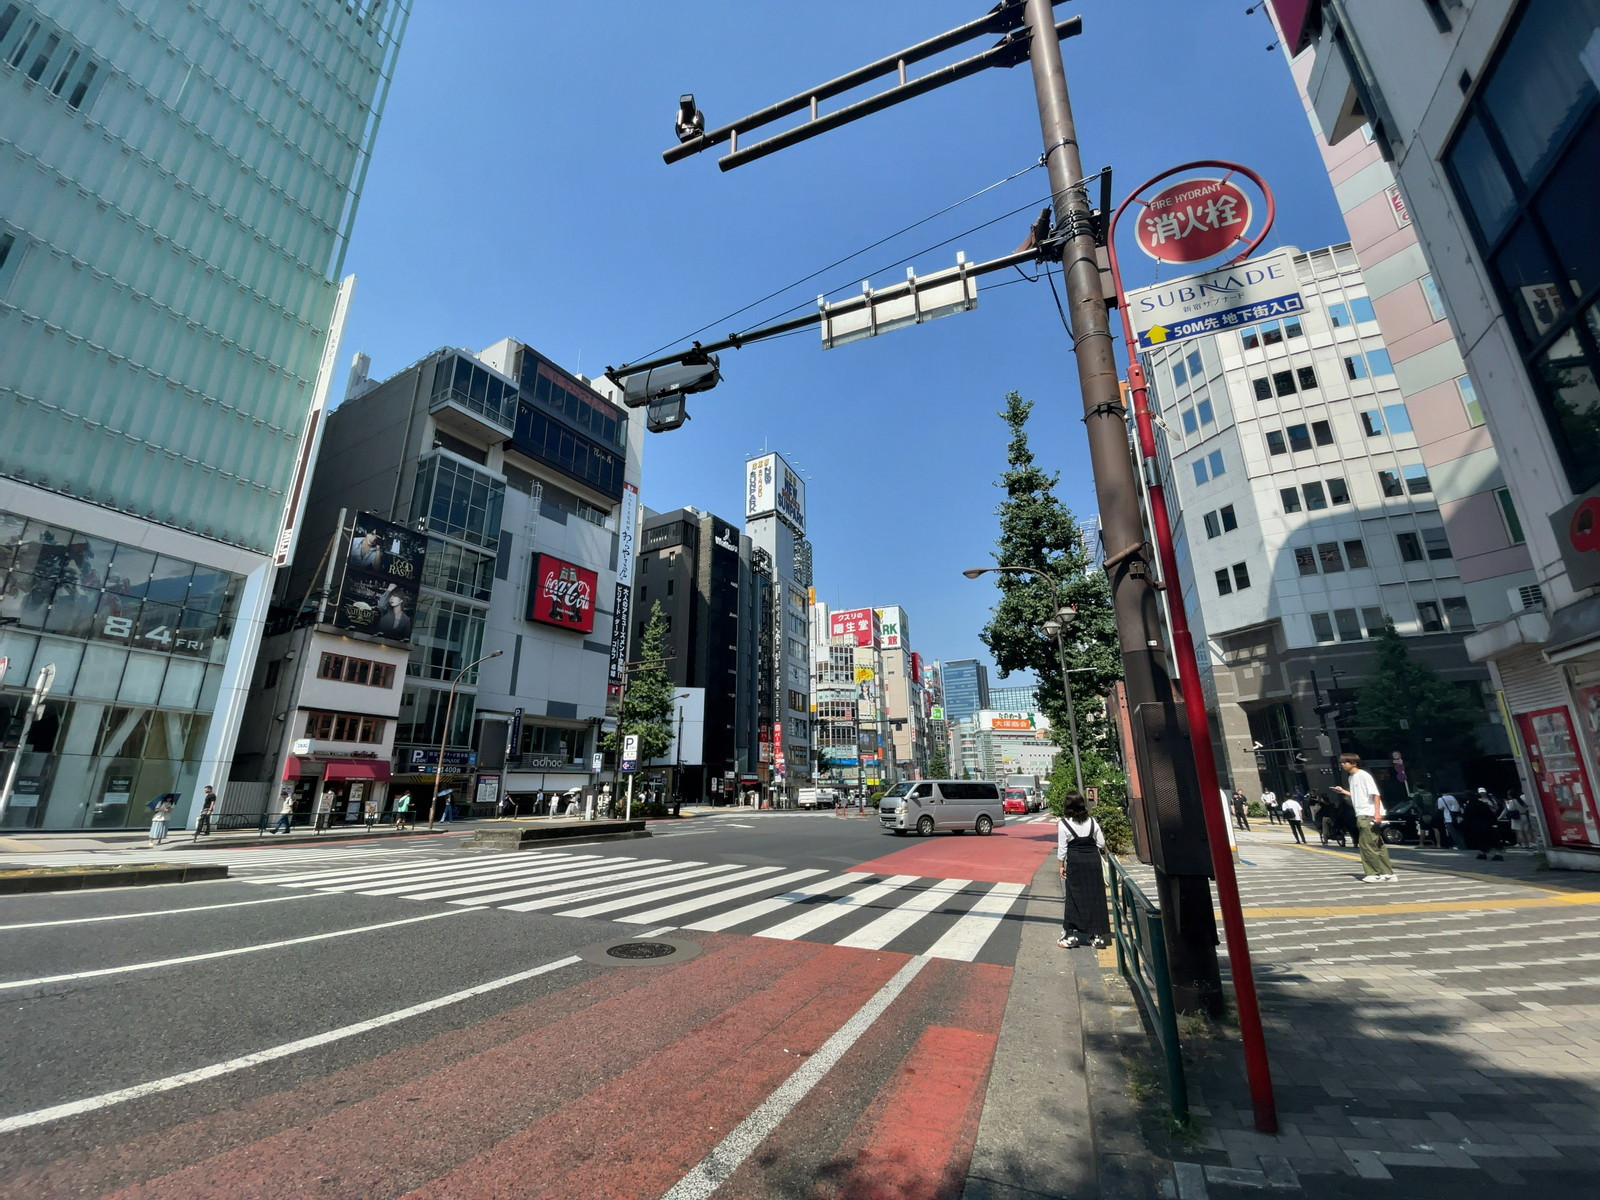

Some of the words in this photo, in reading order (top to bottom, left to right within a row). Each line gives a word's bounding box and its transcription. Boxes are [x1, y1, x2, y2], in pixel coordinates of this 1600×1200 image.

[1150, 198, 1173, 211] FIRE
[1175, 182, 1222, 204] HYDRANT
[1145, 194, 1242, 247] 消火栓
[1140, 262, 1286, 313] SUBNADE
[1174, 315, 1219, 338] 50M先
[1222, 297, 1303, 325] 地下街入口
[749, 471, 757, 513] SUNPARK
[778, 493, 804, 528] SUNPARK
[838, 612, 864, 622] クスリの
[176, 638, 204, 650] FRI
[995, 720, 1027, 728] 大塚商会
[625, 737, 634, 750] P
[532, 756, 563, 768] adhoc
[594, 754, 601, 763] P
